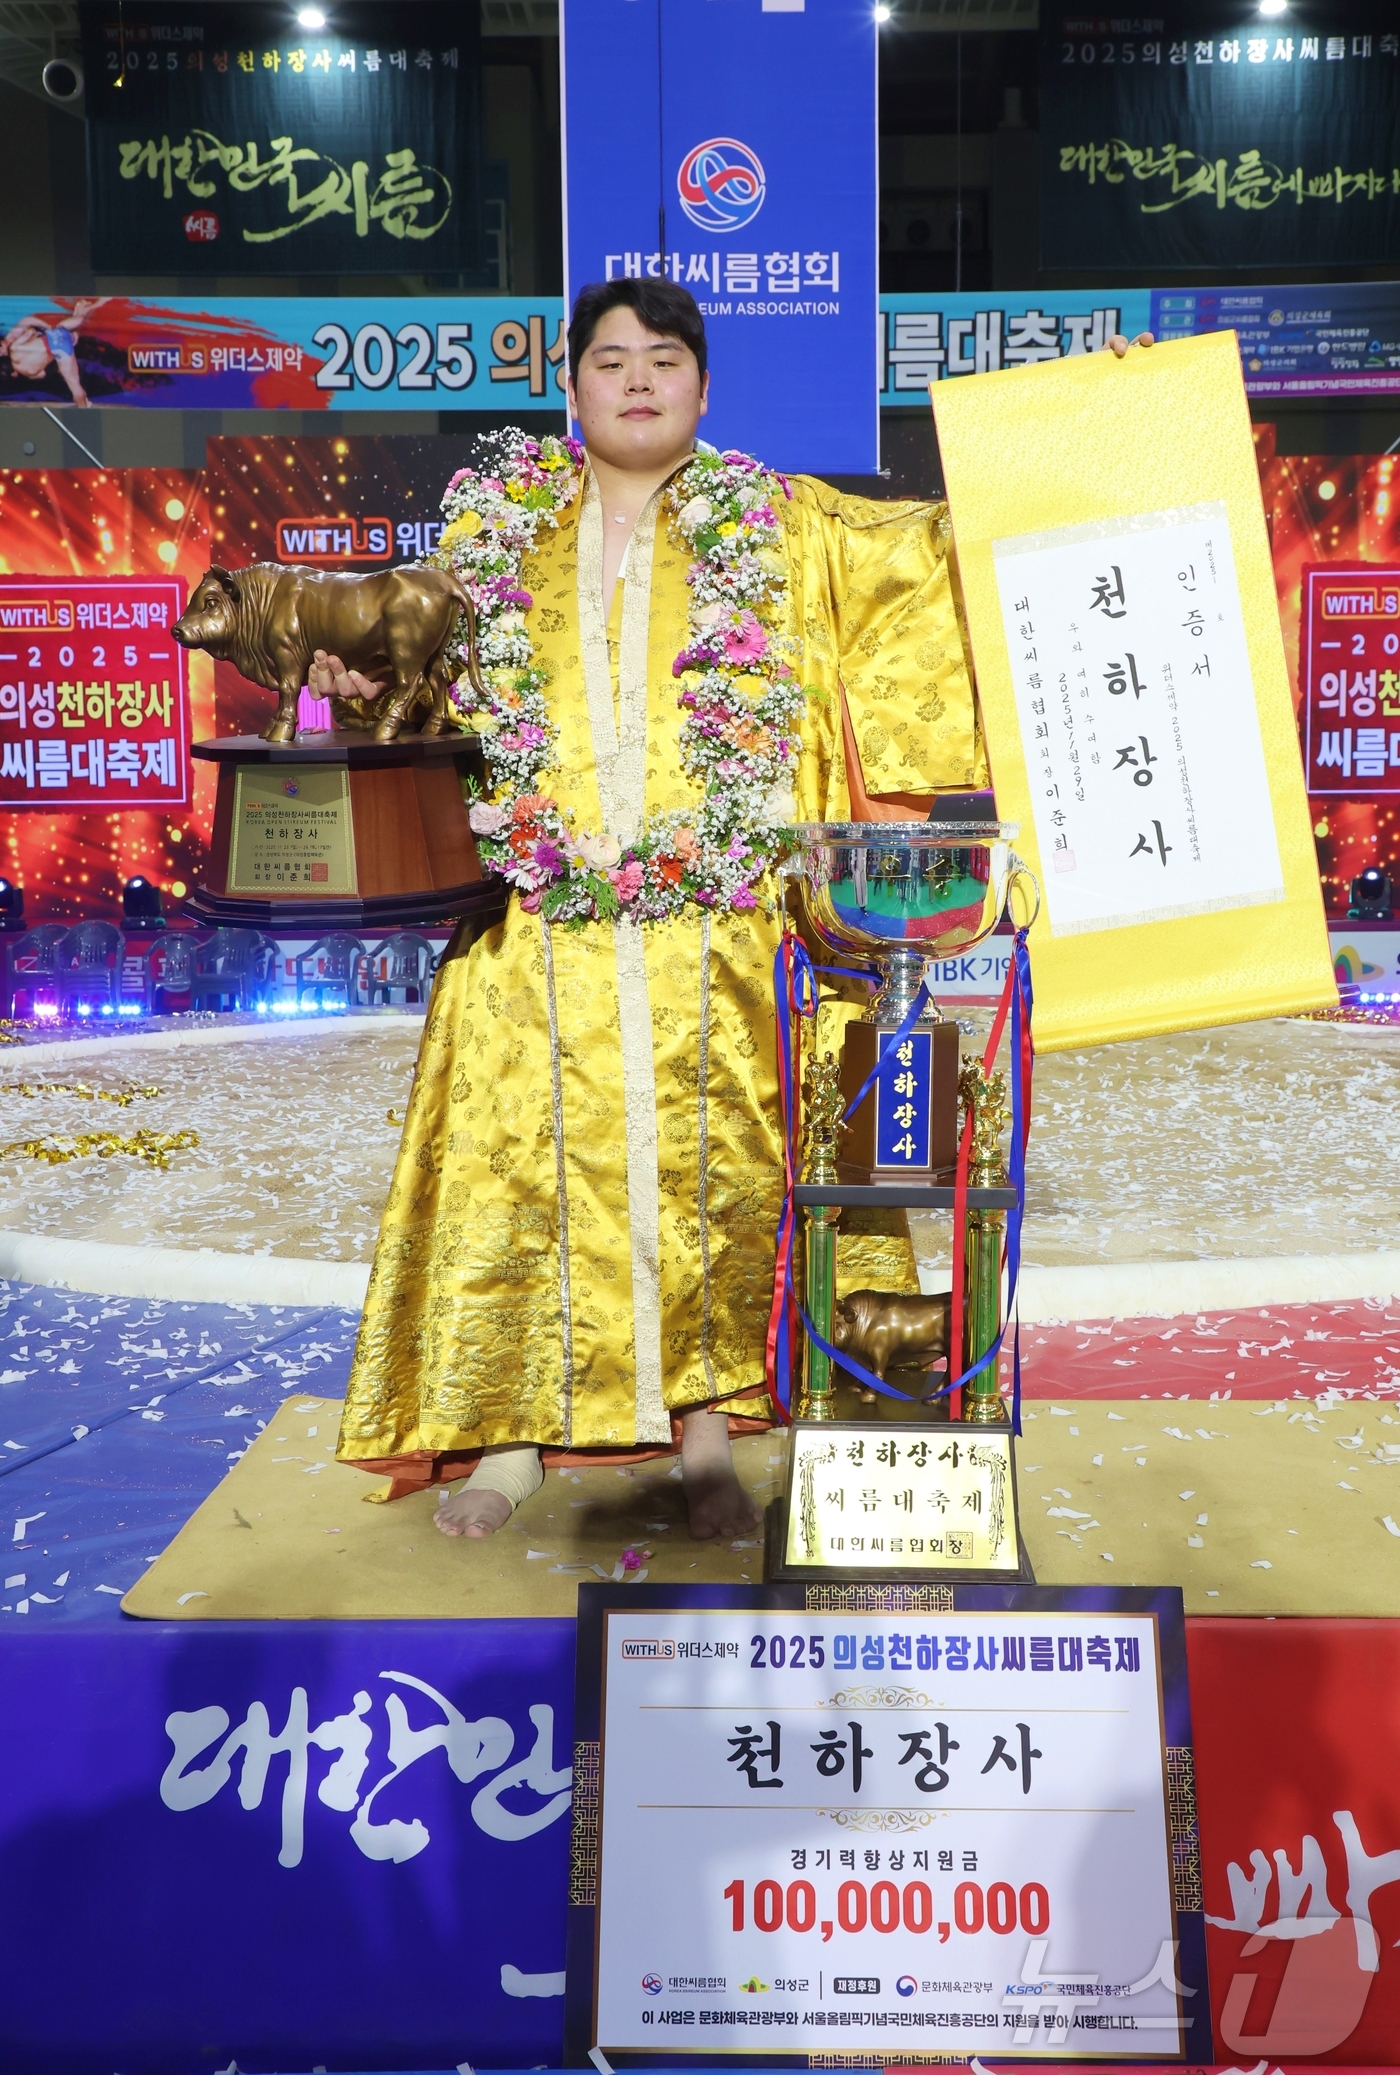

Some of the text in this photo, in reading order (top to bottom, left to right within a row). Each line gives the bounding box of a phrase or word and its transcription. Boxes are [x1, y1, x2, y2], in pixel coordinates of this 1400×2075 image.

[605, 251, 840, 293] 대한씨름협회
[736, 302, 840, 315] ASSOCIATION
[130, 347, 206, 370] WITHUS
[210, 347, 303, 371] 위더스제약
[313, 323, 476, 391] 2025
[280, 523, 389, 556] WITHUS
[2, 602, 168, 629] WITHUS 위더스제약
[1324, 591, 1399, 617] WITHUS
[1177, 564, 1212, 678] 인증서
[1088, 565, 1173, 868] 천하장사
[1172, 716, 1183, 751] 2025
[1, 739, 176, 788] 씨름대축제
[246, 811, 262, 819] 2025
[264, 828, 318, 840] 천하장사
[254, 862, 310, 871] 대한씨름협회
[892, 1039, 919, 1160] 천하장사
[846, 1439, 964, 1469] 천하장사
[823, 1487, 983, 1515] 씨름대축제
[623, 1633, 1140, 1673] WITHUS 위더스제약 2025 의성천하장사씨름대축제
[726, 1720, 1043, 1795] 천하장사
[789, 1848, 979, 1872] 경기력향상지원금
[722, 1879, 1051, 1945] 100,000,000
[668, 1976, 726, 1988] 대한씨름협회
[774, 1978, 809, 1992] 의성군
[837, 1979, 878, 1993] 재정후원
[921, 1981, 994, 1993] 문화체육관광부
[1005, 1984, 1132, 1997] KSPO 국민체육진흥공단
[642, 2010, 1139, 2031] 이 사업은 문화체육관광부와 서울올림픽기념국민체육진흥공단의 지원을 받아 시행합니다.
